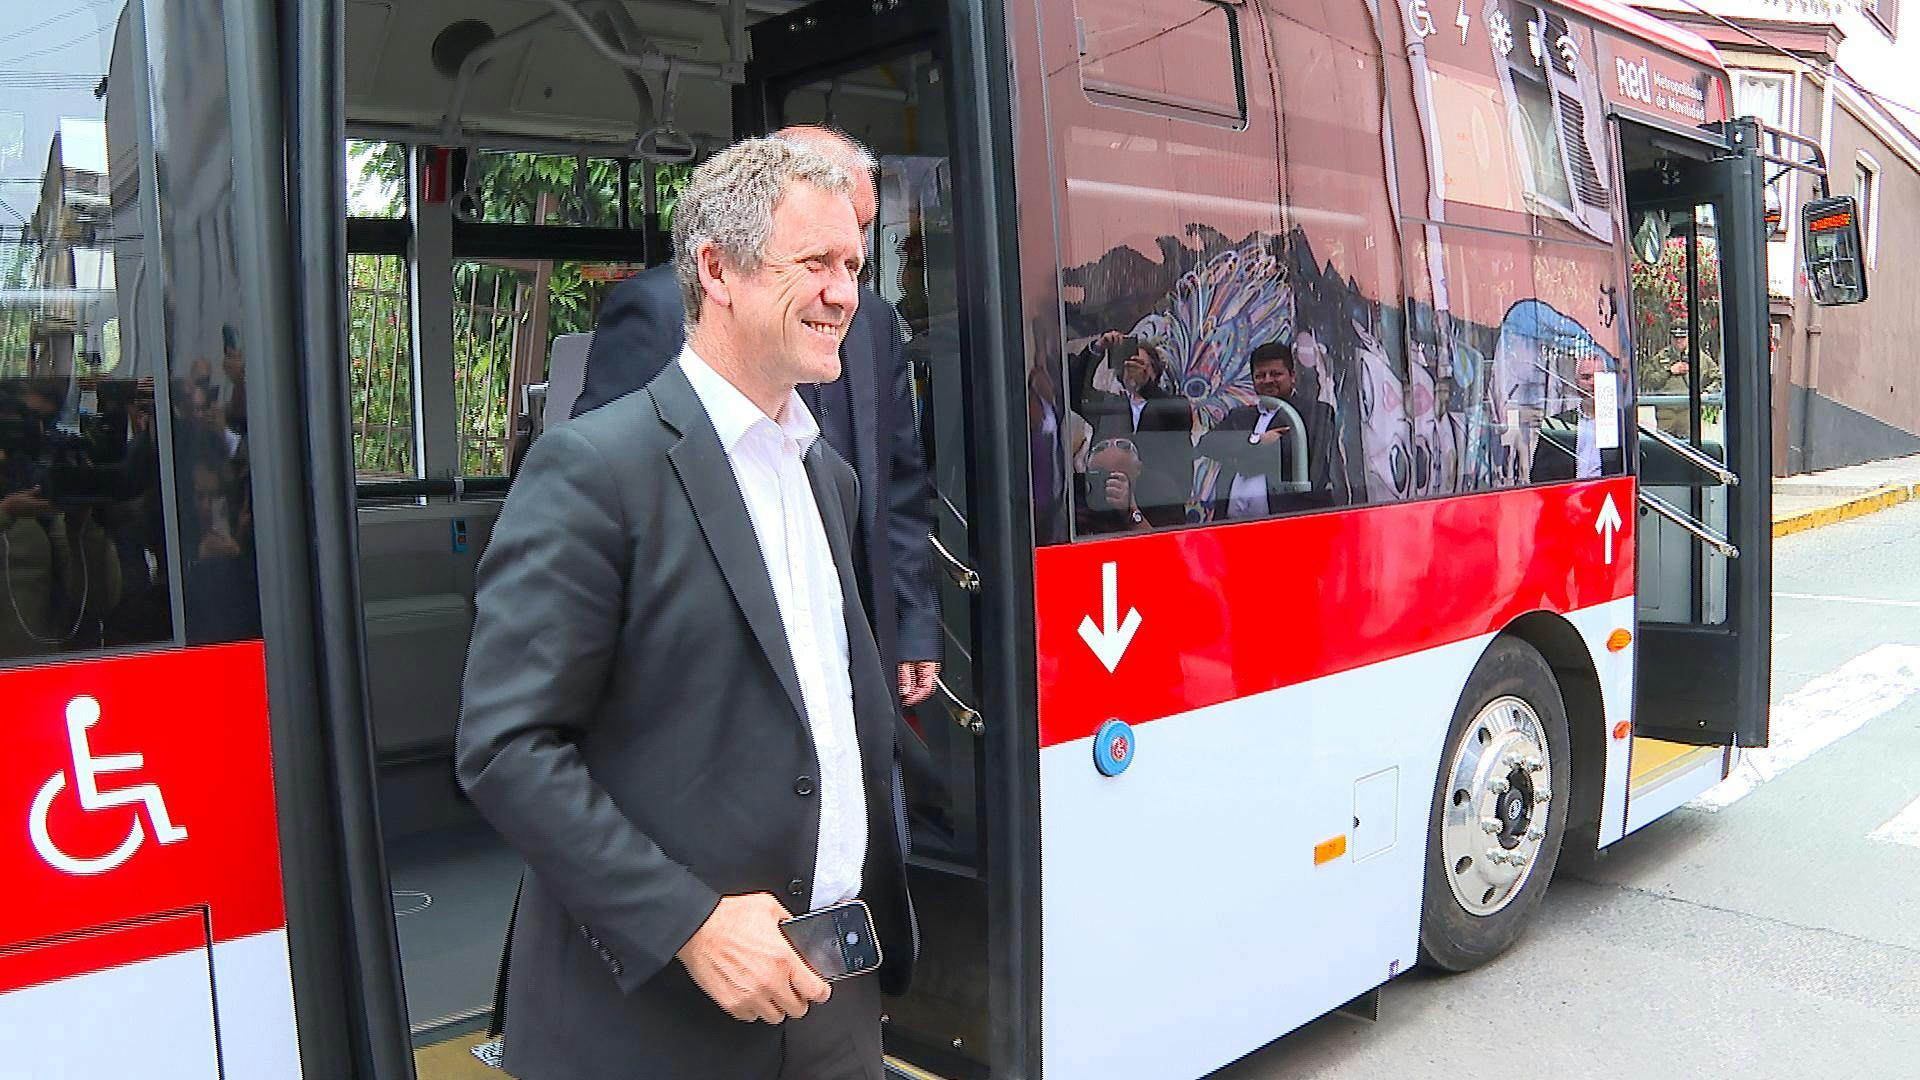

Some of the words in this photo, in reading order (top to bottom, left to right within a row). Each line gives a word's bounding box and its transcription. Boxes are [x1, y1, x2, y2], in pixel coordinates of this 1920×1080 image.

[1615, 56, 1652, 105] Red
[1655, 92, 1667, 110] de
[1668, 95, 1706, 121] Movilidad
